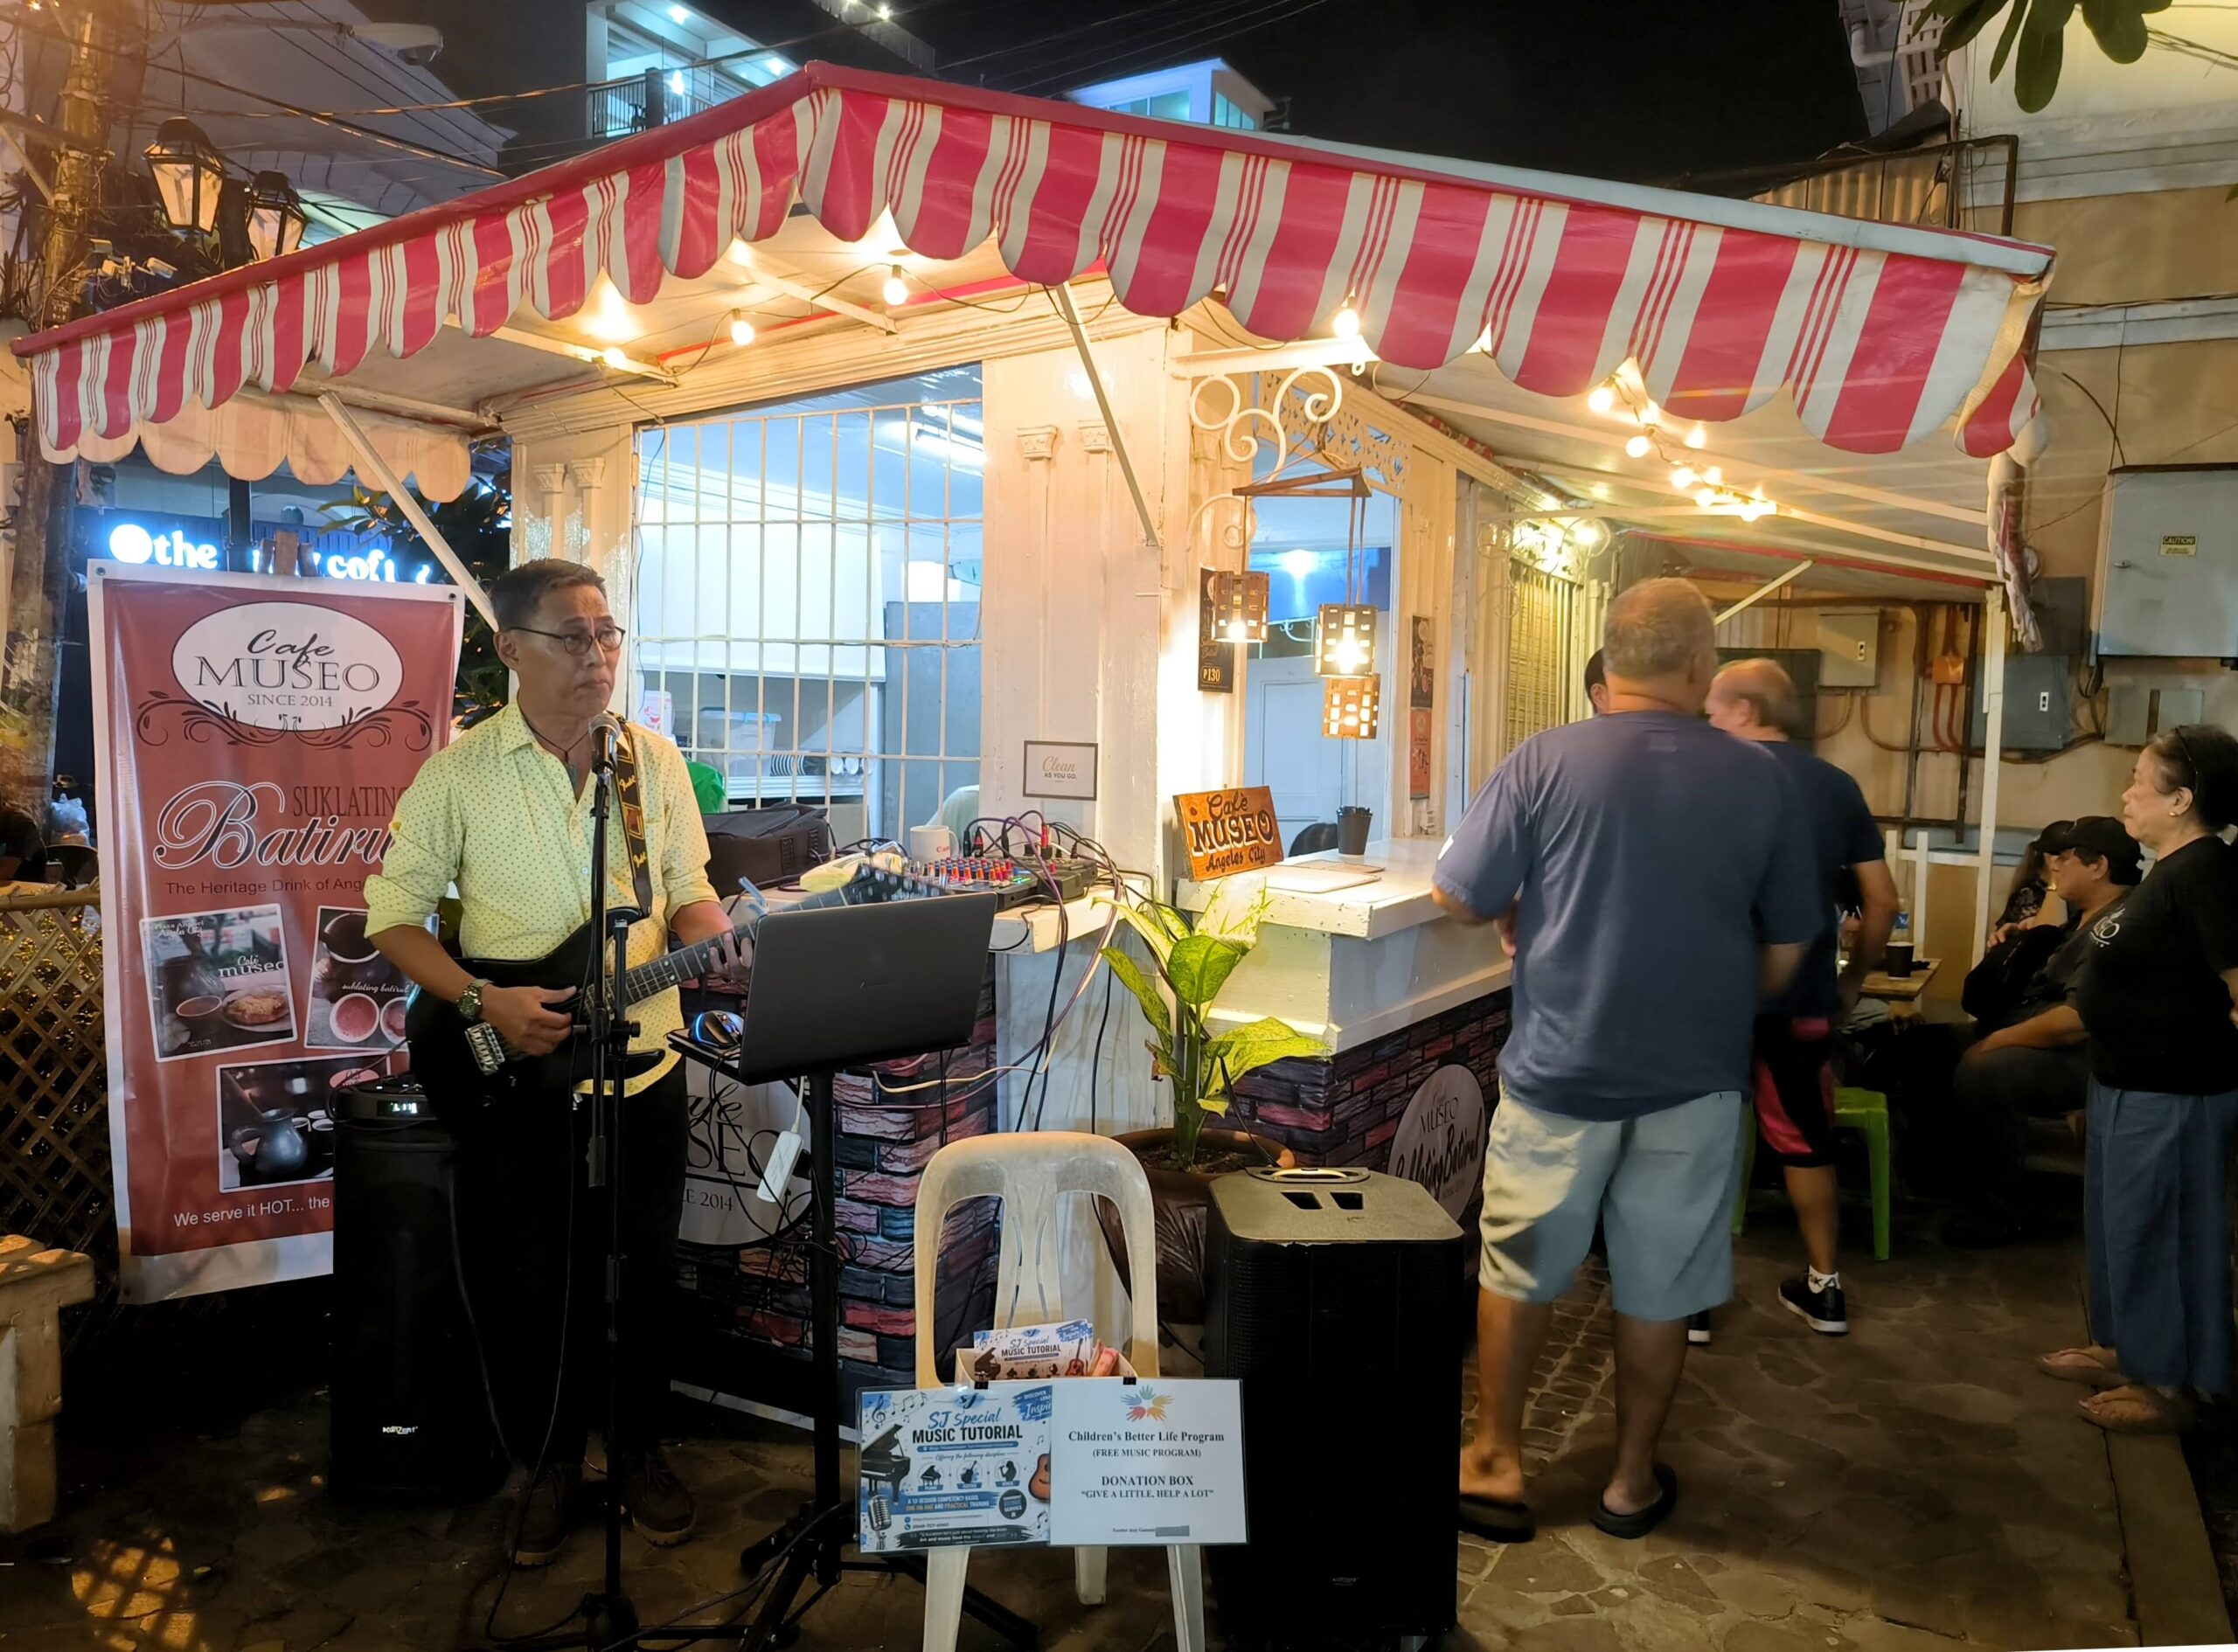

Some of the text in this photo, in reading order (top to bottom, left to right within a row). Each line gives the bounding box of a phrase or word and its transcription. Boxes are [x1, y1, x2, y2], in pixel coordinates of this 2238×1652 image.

[152, 529, 219, 570] the
[247, 628, 335, 670] Cafe
[193, 656, 380, 692] MUSEO
[247, 694, 333, 707] SINCE 2014
[1042, 755, 1076, 773] Clean
[153, 780, 396, 871] Batiru
[1189, 809, 1274, 857] MUSEO
[1206, 844, 1266, 873] Angeles City
[166, 877, 365, 896] The Heritage Drink of Ang
[700, 1191, 734, 1211] 2014
[174, 1196, 330, 1227] We serve it HOT... the
[1001, 1343, 1061, 1357] MUSIC TUTORIAL
[928, 1407, 1002, 1430] SJ Special
[912, 1424, 1023, 1444] MUSIC TUTORIAL
[1067, 1431, 1225, 1444] Children's Better Life Program
[1092, 1448, 1202, 1458] (FREE MUSIC PROGRAM)
[1101, 1475, 1194, 1486] DONATION BOX
[1119, 1489, 1155, 1500] LITTLE,
[1157, 1489, 1181, 1498] HELP
[1183, 1489, 1190, 1498] A
